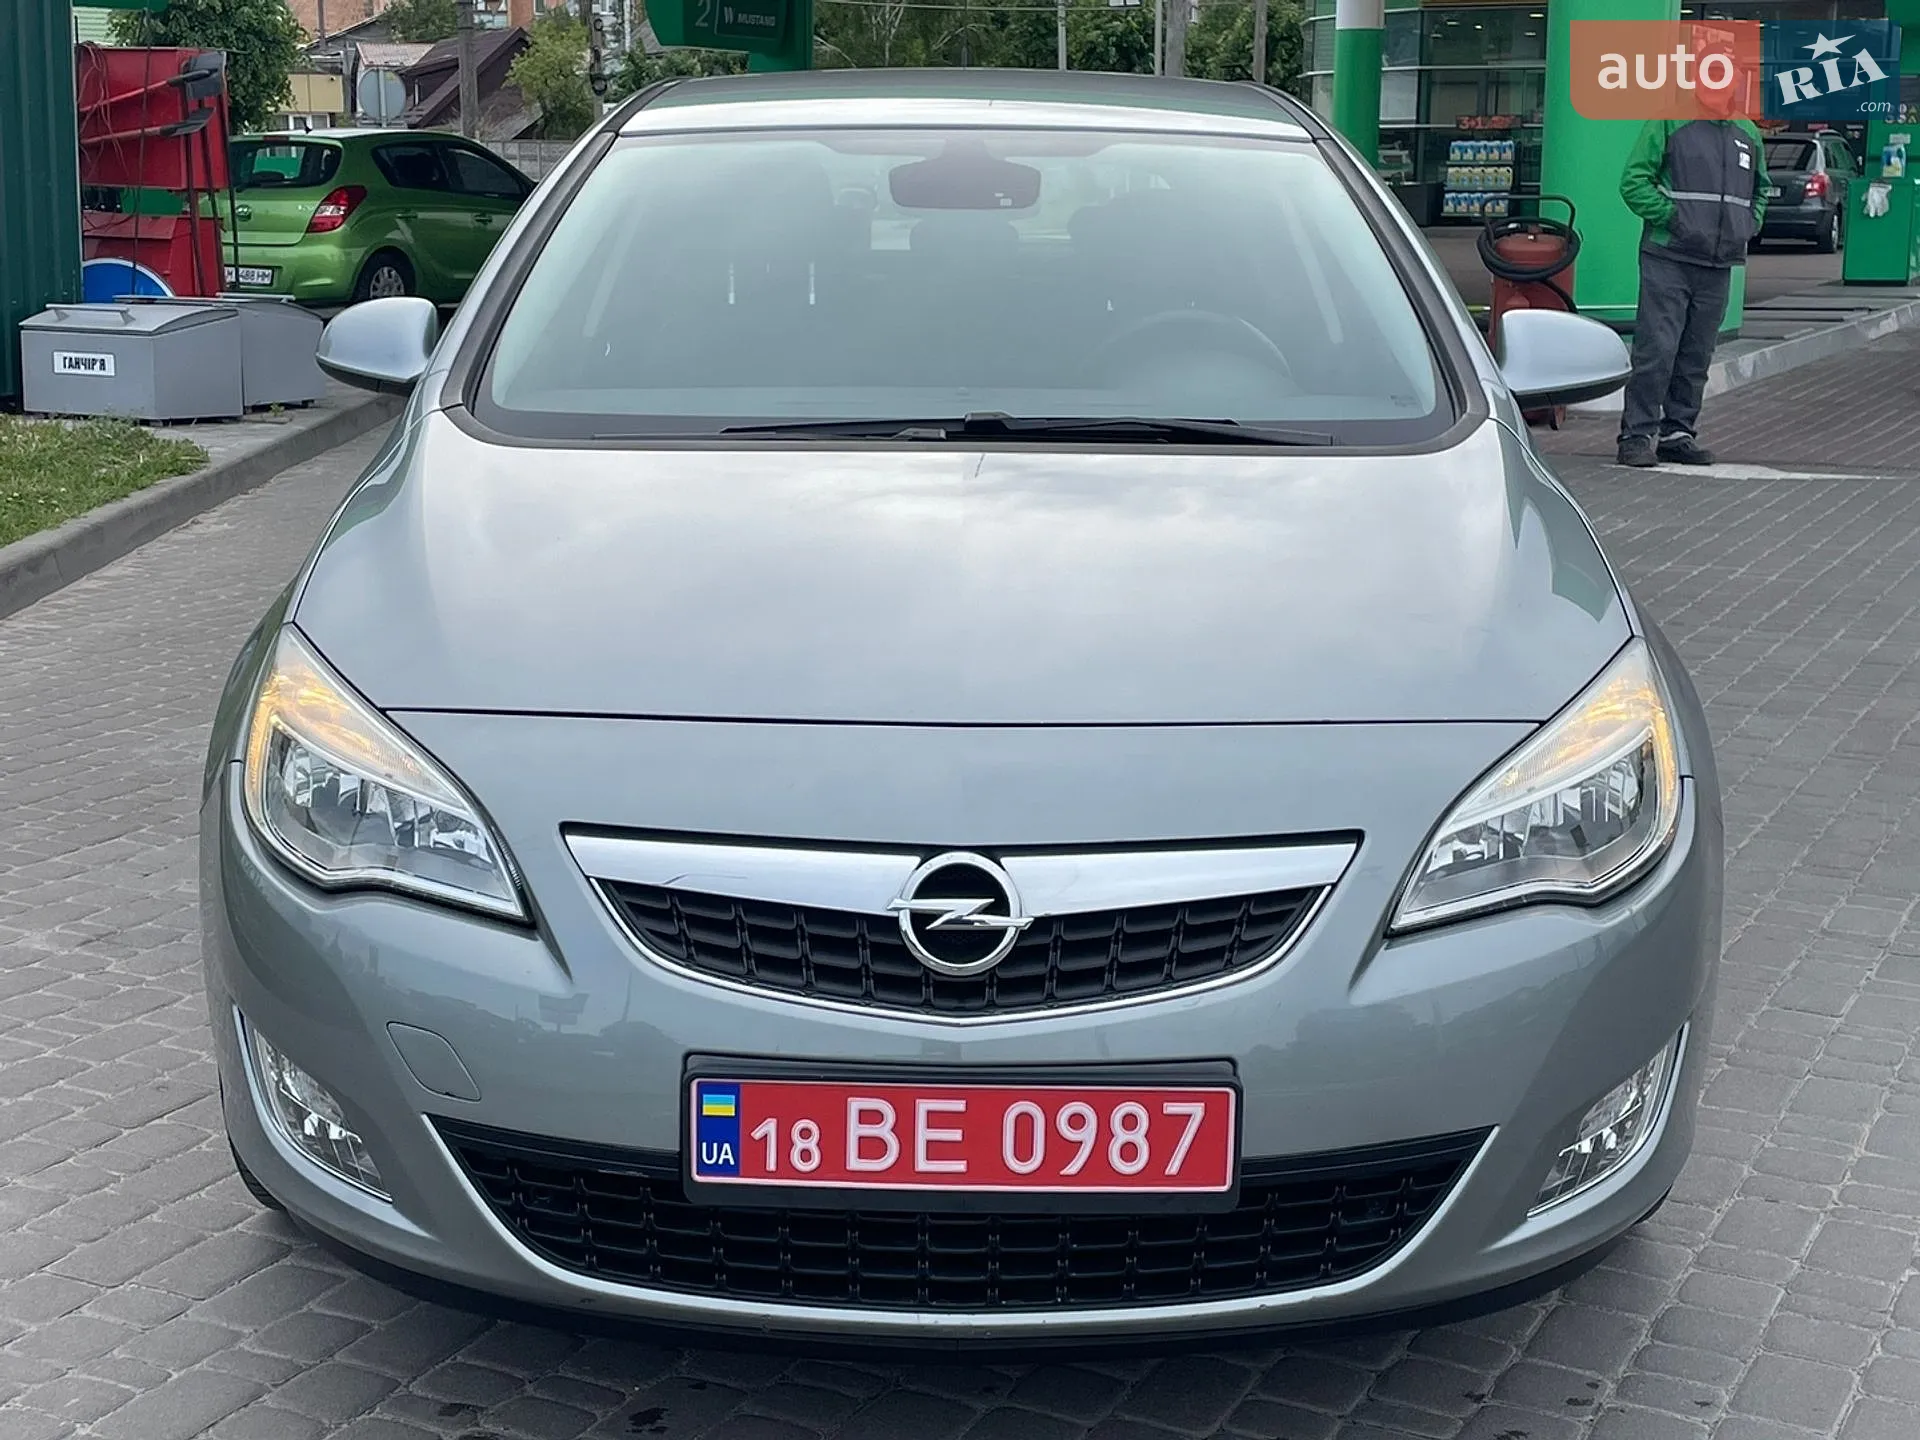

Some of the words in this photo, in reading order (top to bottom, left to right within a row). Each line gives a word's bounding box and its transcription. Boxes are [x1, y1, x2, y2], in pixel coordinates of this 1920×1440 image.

[701, 1141, 735, 1166] UA
[750, 1117, 822, 1173] 18
[846, 1096, 968, 1174] BE
[1001, 1100, 1206, 1176] 0987
